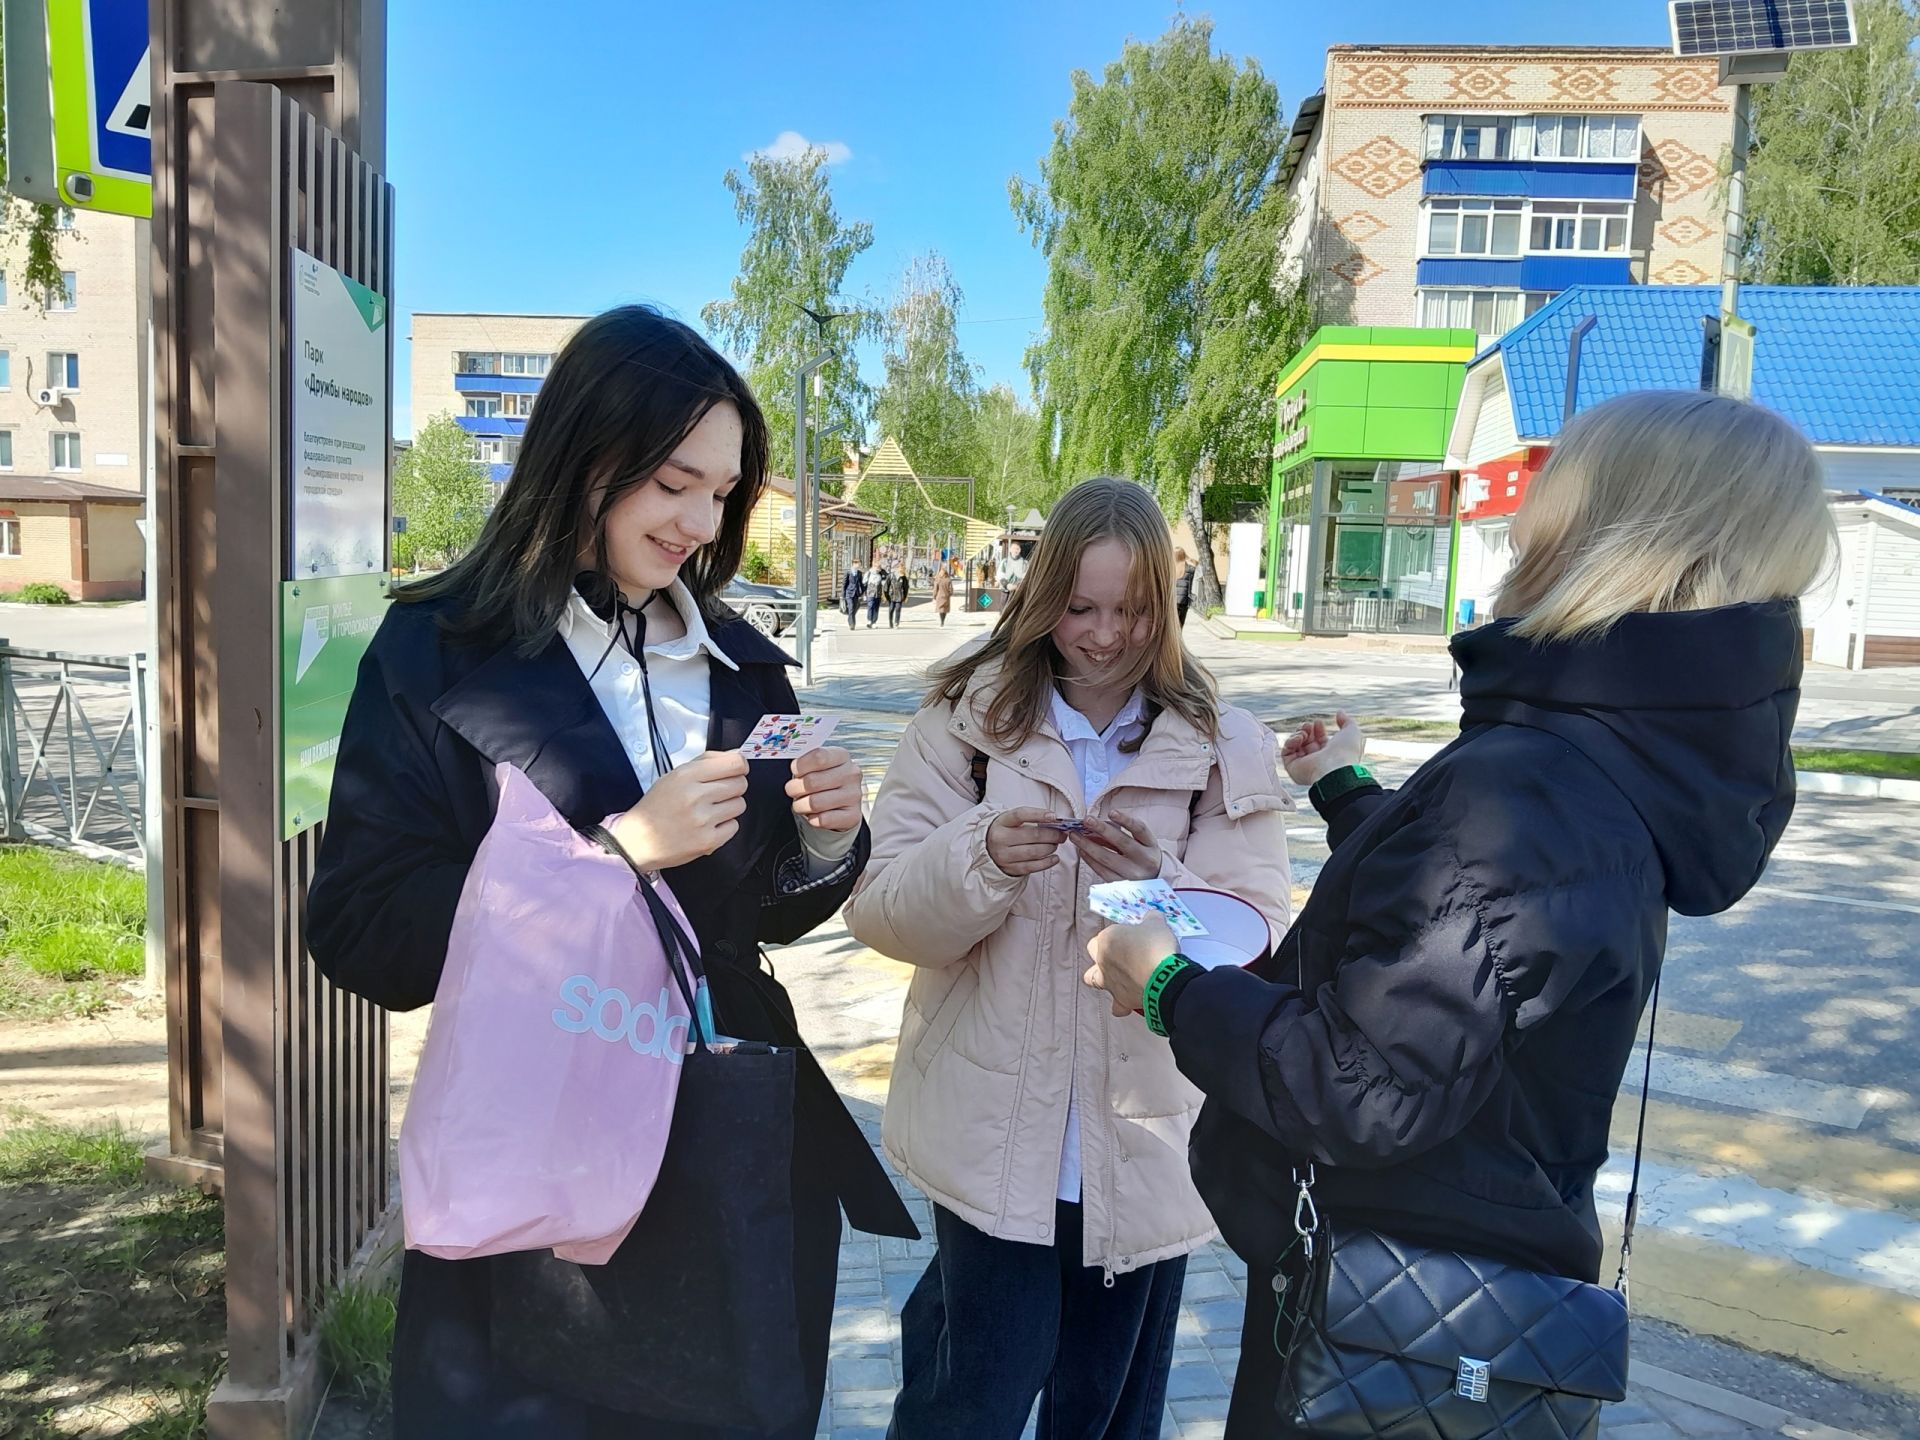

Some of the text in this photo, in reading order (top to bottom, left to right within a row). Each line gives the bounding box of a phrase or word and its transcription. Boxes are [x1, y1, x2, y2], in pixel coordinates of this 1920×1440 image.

[304, 340, 324, 366] Парк
[304, 373, 373, 407] «Дружбы народов»
